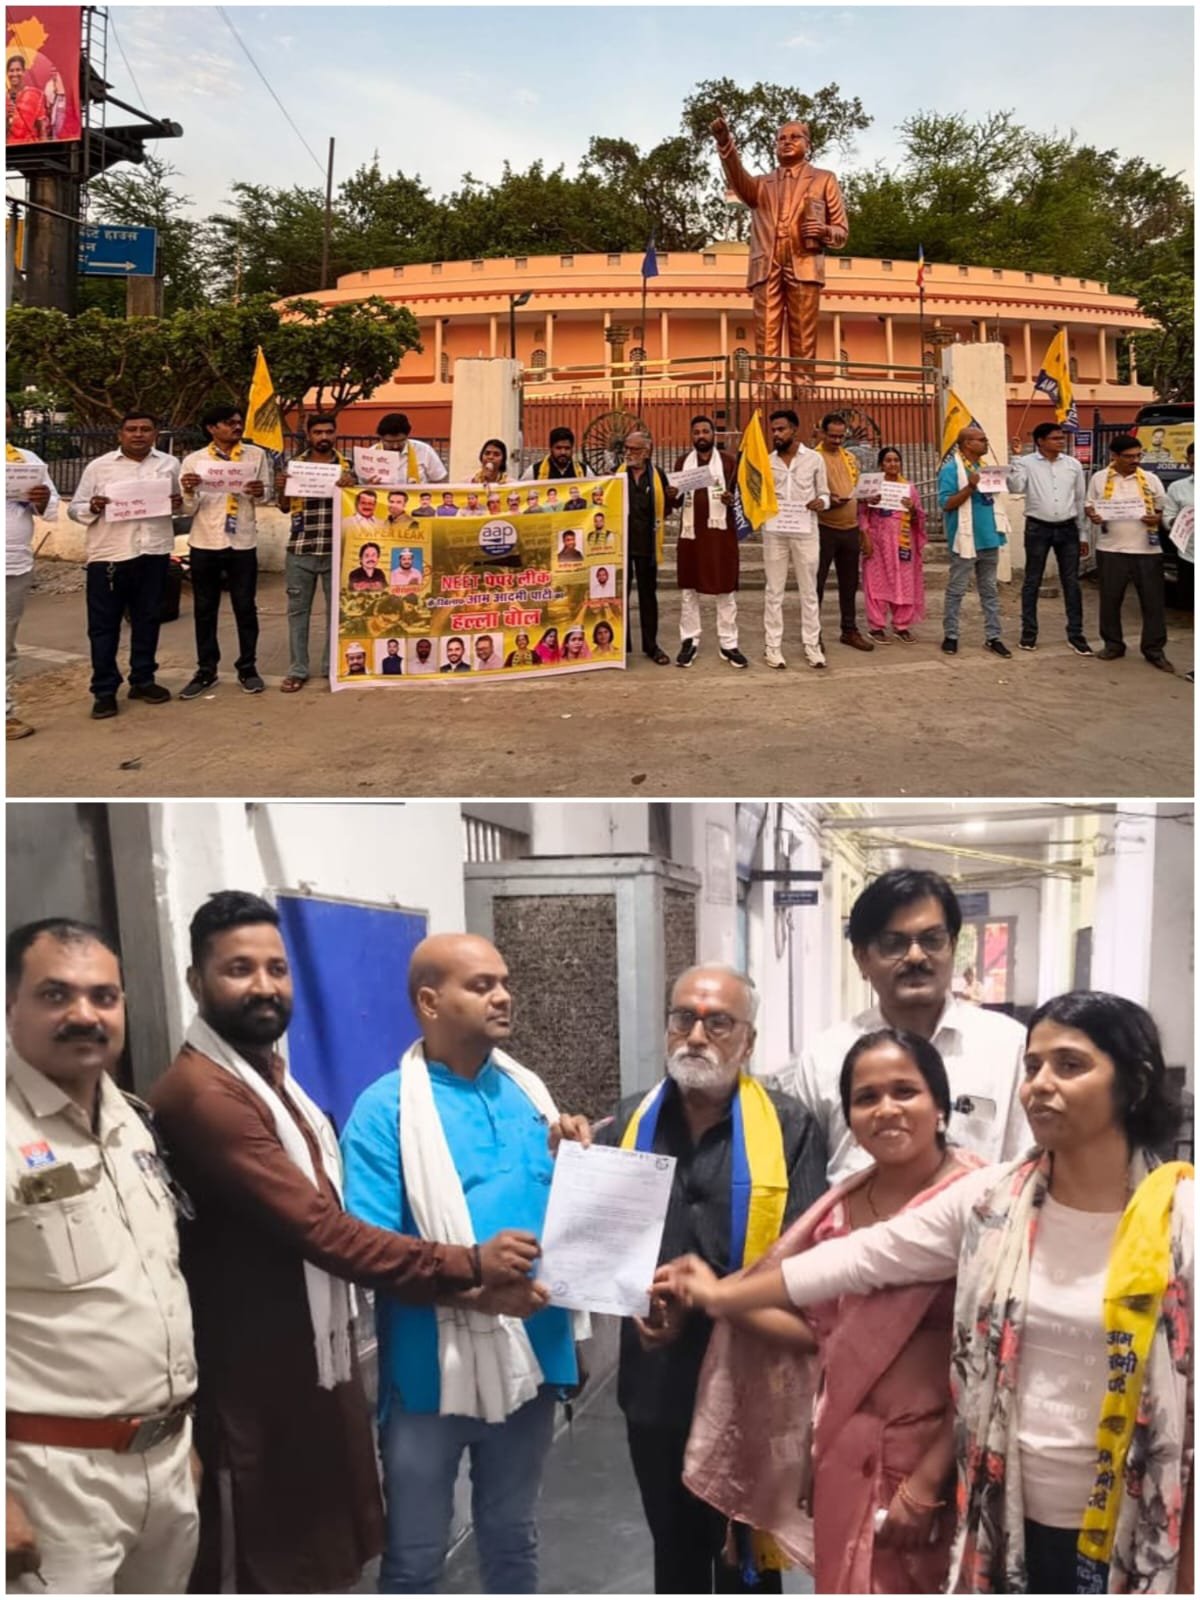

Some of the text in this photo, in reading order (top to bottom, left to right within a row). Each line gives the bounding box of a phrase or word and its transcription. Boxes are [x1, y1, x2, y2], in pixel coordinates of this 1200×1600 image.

[483, 526, 513, 545] aap
[441, 568, 552, 591] NEET पेपर लीक
[467, 593, 490, 604] आम
[494, 590, 527, 602] आदमी
[451, 605, 543, 631] हल्ला बोल
